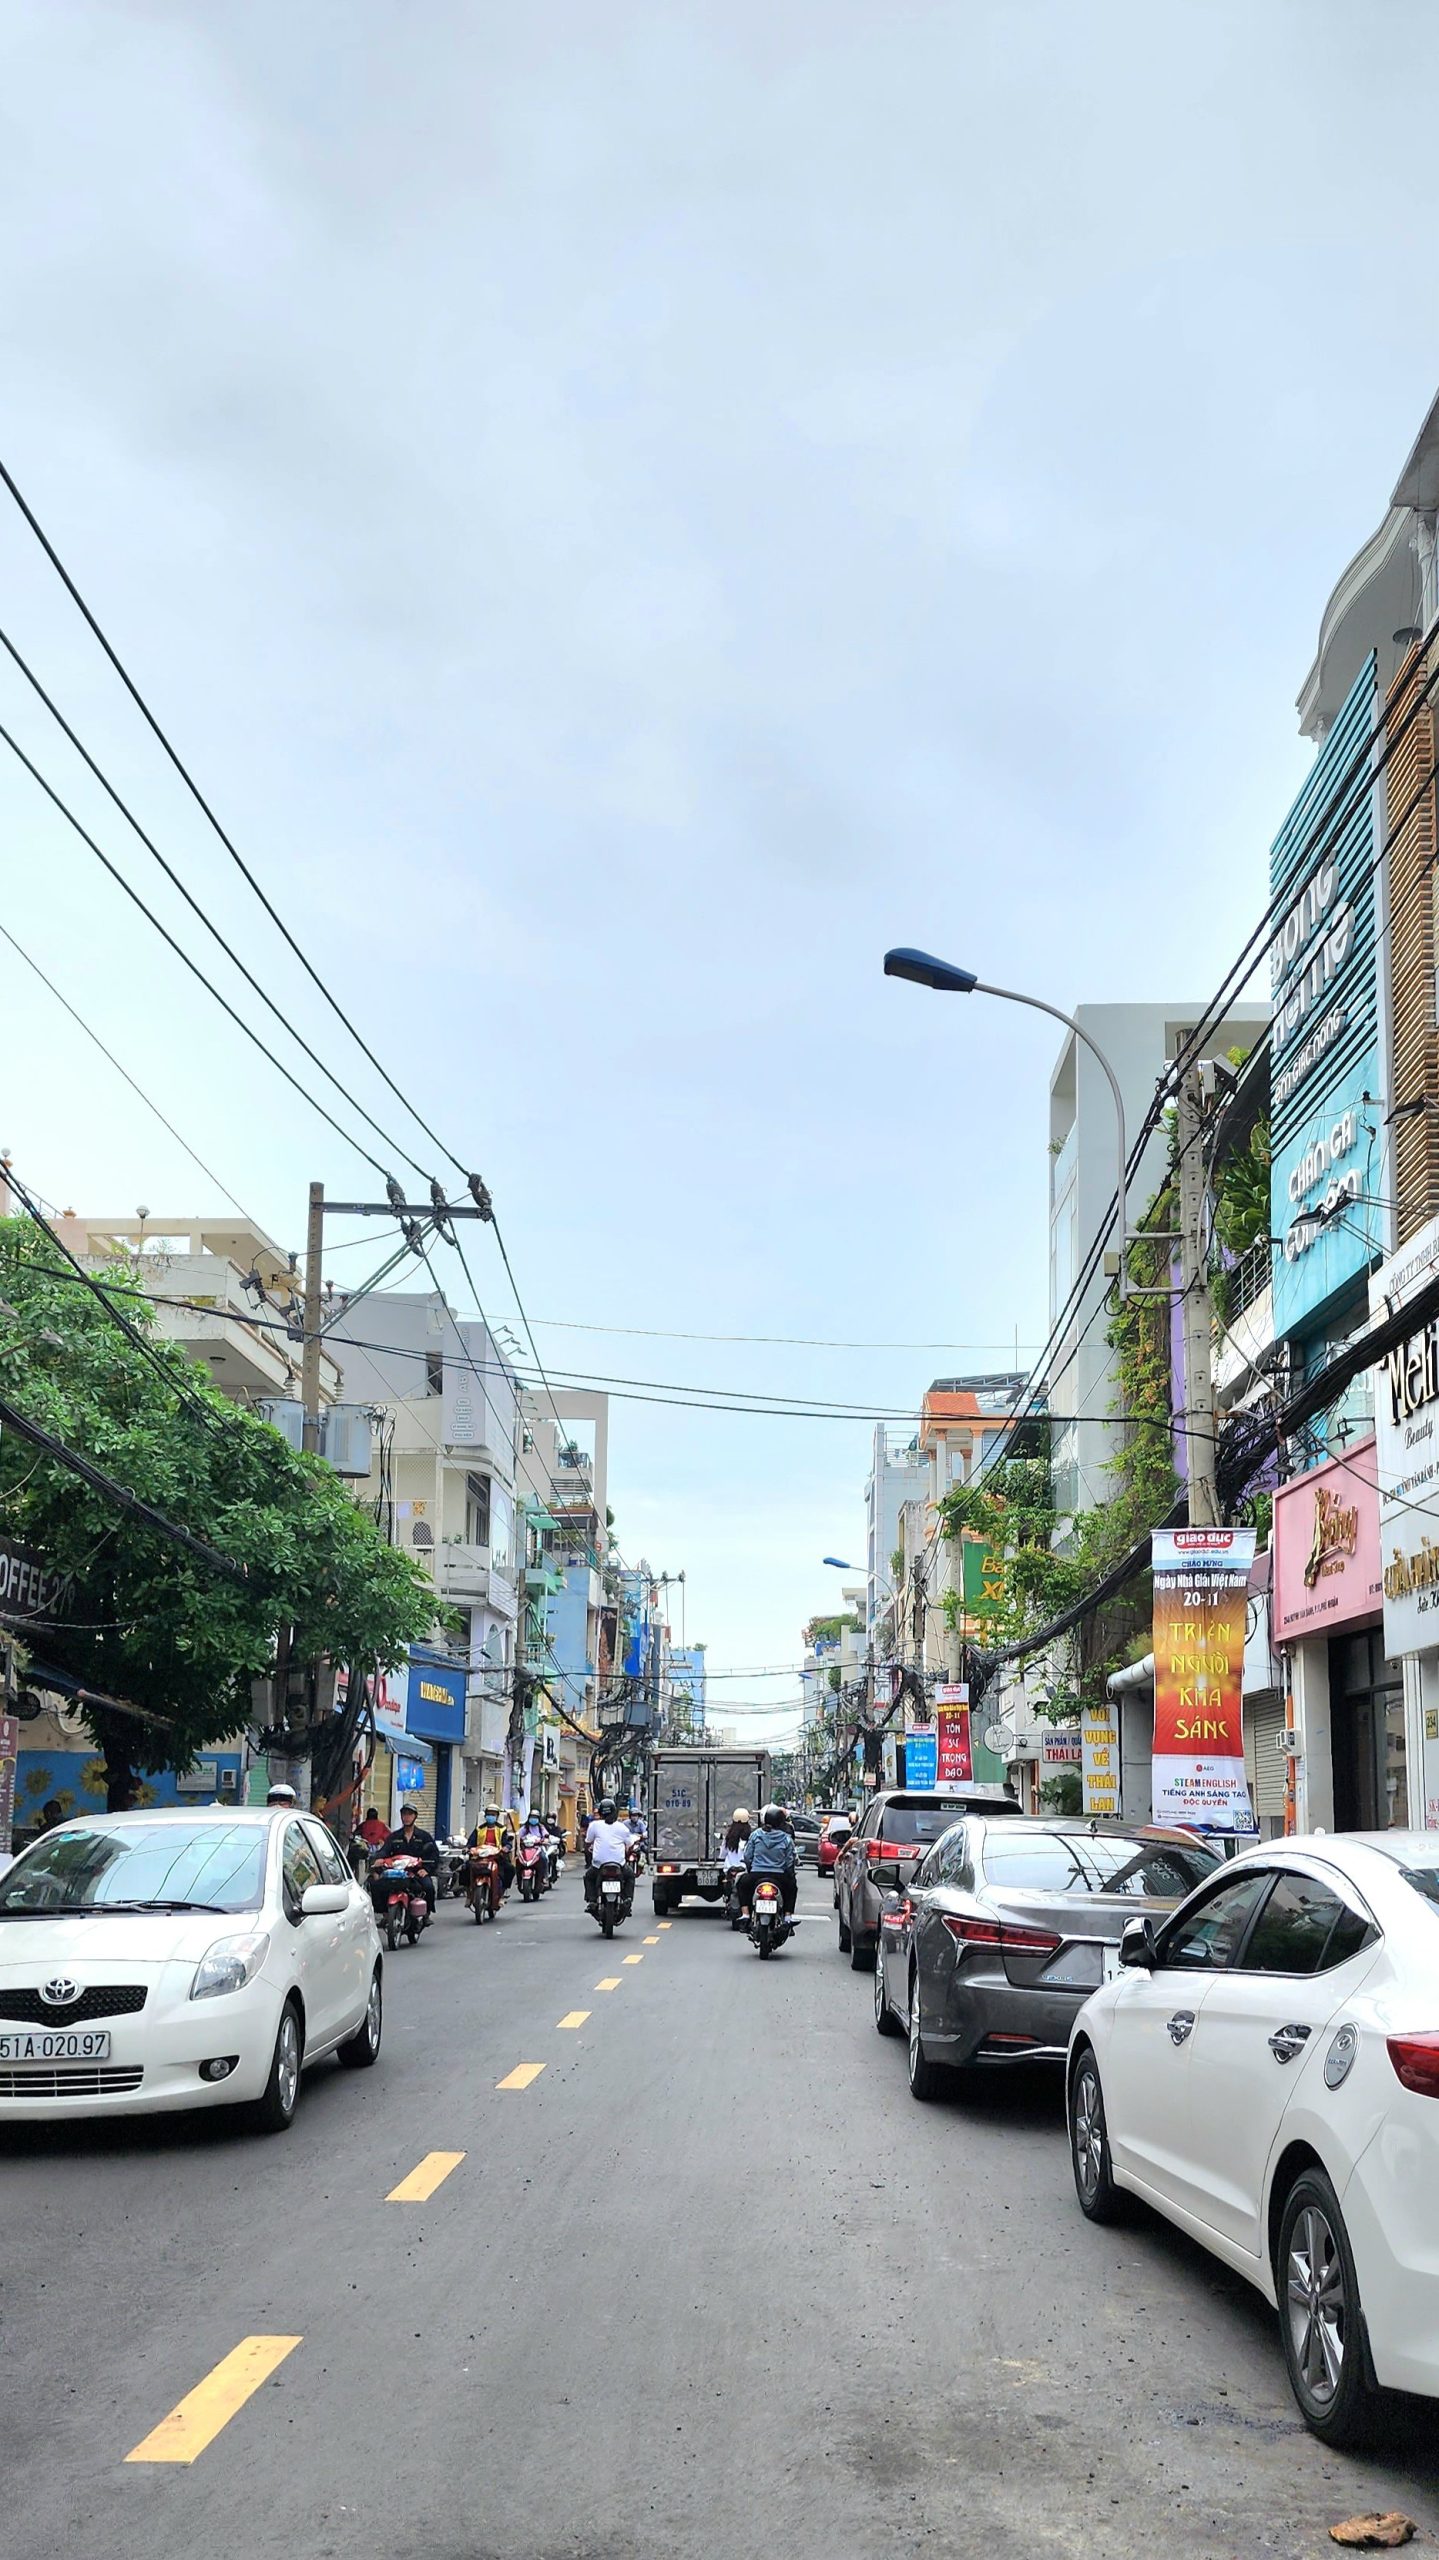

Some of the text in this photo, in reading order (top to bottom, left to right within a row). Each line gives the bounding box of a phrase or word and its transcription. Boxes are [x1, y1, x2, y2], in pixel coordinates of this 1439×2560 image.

[1154, 1574, 1176, 1590] Ngày
[1177, 1573, 1193, 1588] Nhà
[1228, 1574, 1247, 1588] Nam
[1046, 1746, 1069, 1760] THÁI
[942, 1753, 967, 1764] TRỌNG
[945, 1768, 963, 1778] ĐẠO
[1087, 1771, 1117, 1788] THÁI
[1174, 1778, 1237, 1788] STEAM ENGLISH
[672, 1789, 687, 1797] 51C
[1162, 1788, 1187, 1797] TIẾNG
[1189, 1789, 1206, 1797] ANH
[1207, 1789, 1230, 1798] SÁNG
[1090, 1797, 1115, 1812] LAN
[1183, 1798, 1228, 1806] ĐỘC QUYỀN
